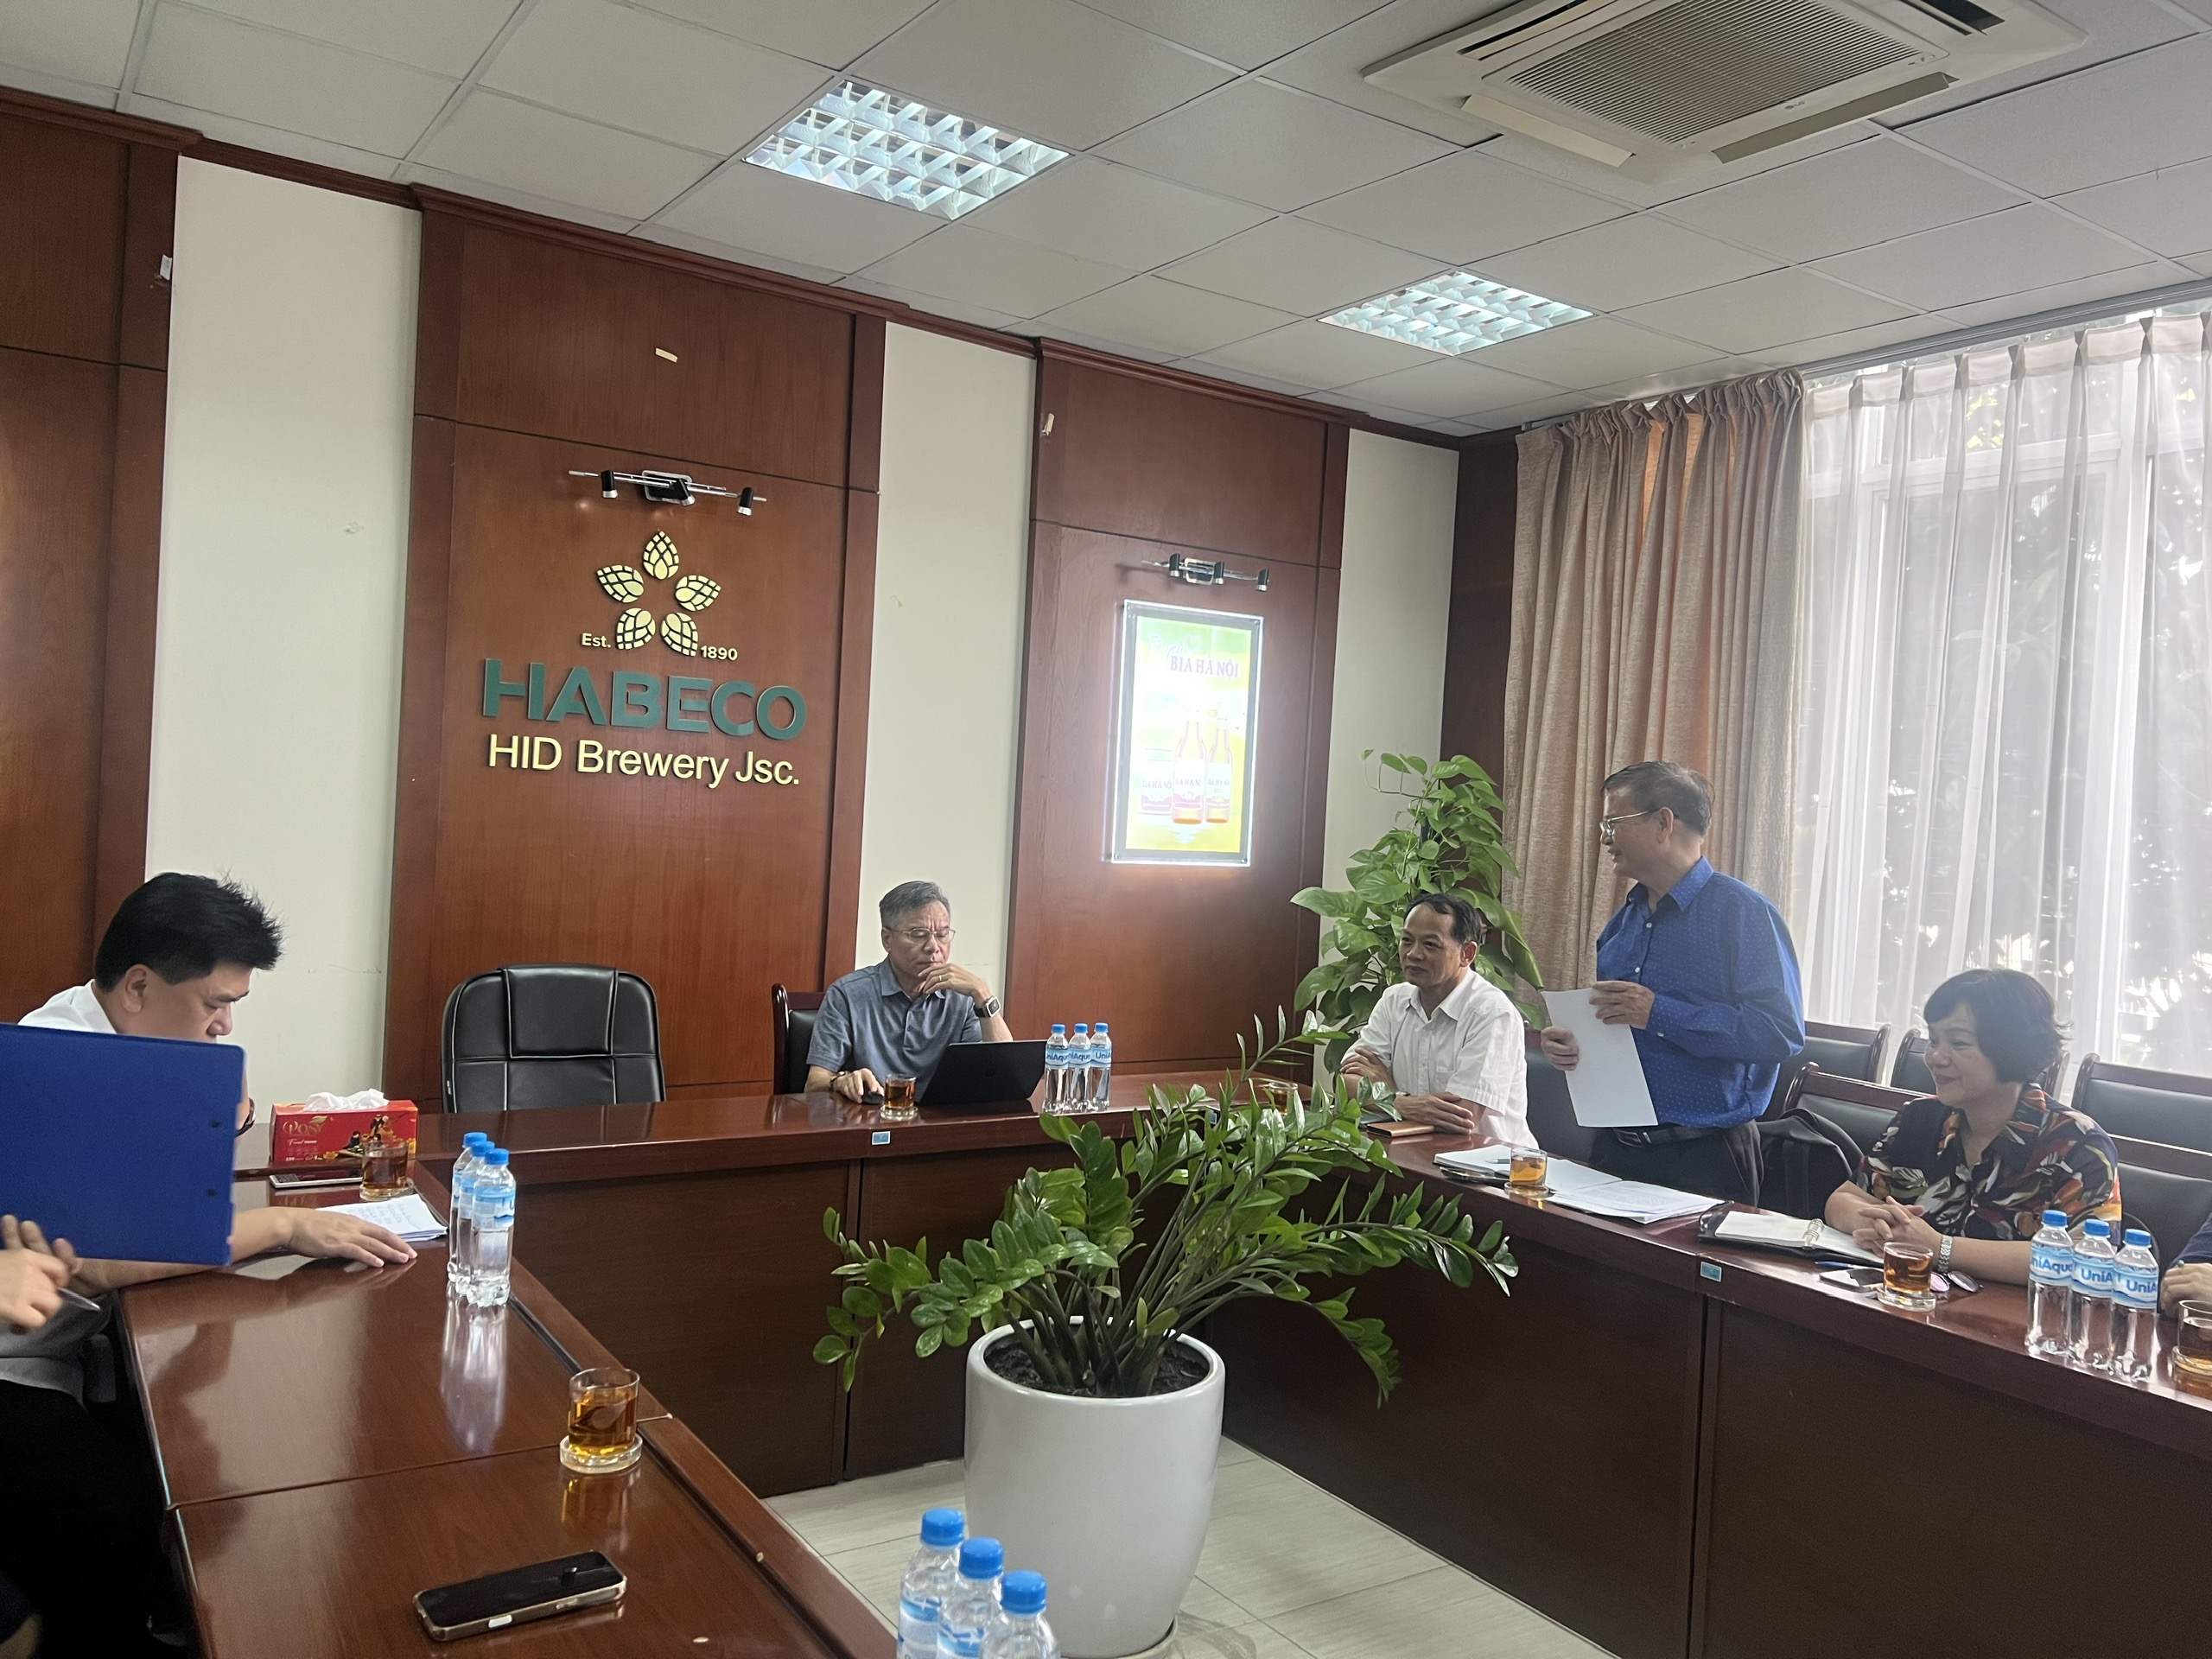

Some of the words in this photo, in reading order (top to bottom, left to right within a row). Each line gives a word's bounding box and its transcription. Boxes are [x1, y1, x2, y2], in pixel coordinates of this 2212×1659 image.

[581, 632, 612, 648] Est.
[700, 645, 738, 661] 1890
[1170, 655, 1192, 672] BIA
[1195, 654, 1214, 676] HÀ
[1216, 658, 1239, 681] NỘI
[482, 658, 807, 741] HABECO
[488, 734, 563, 771] HID
[576, 739, 730, 789] Brewery
[734, 751, 800, 785] Jsc.
